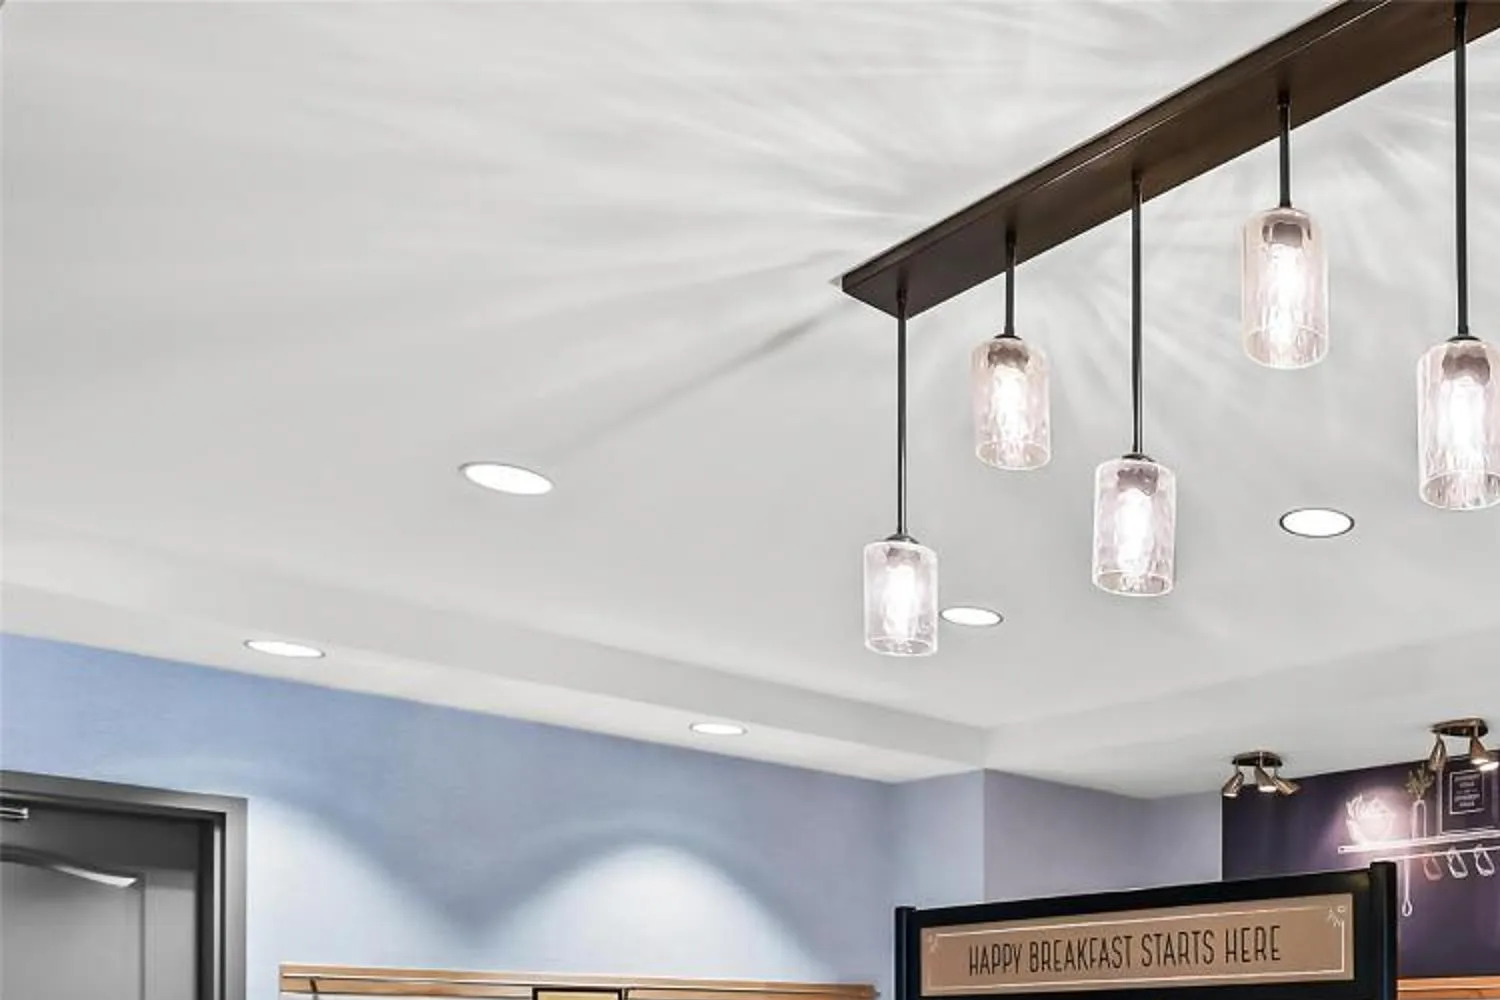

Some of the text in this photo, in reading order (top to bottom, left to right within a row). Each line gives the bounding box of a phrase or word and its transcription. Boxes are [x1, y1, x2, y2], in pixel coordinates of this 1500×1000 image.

[968, 925, 1282, 977] HAPPY BREAKFAST STARTS HERE
